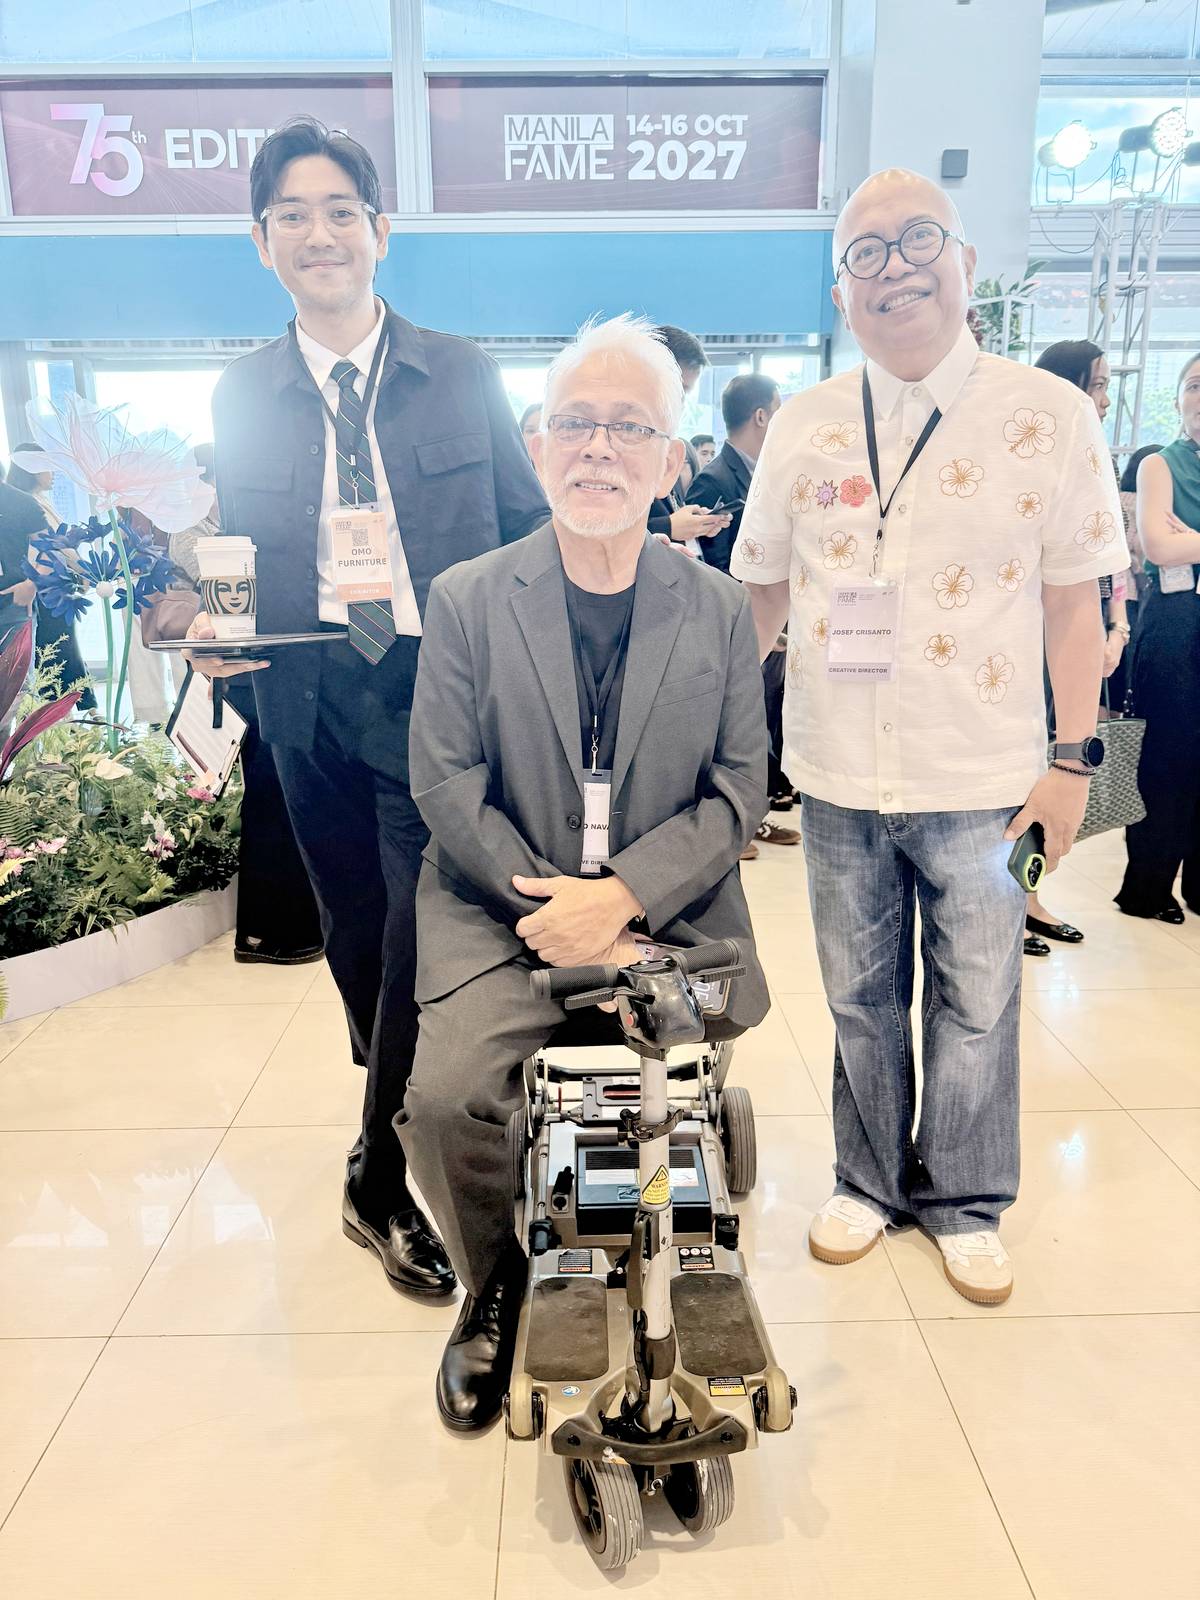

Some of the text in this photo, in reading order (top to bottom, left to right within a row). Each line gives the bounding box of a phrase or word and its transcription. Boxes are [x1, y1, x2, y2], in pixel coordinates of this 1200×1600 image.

[507, 116, 610, 142] MANILA
[626, 114, 748, 136] 14-16 OCT
[50, 103, 147, 197] 75th
[504, 144, 615, 180] FAME
[626, 140, 748, 181] 2027
[338, 557, 388, 568] FURNITURE
[351, 547, 372, 556] OMO
